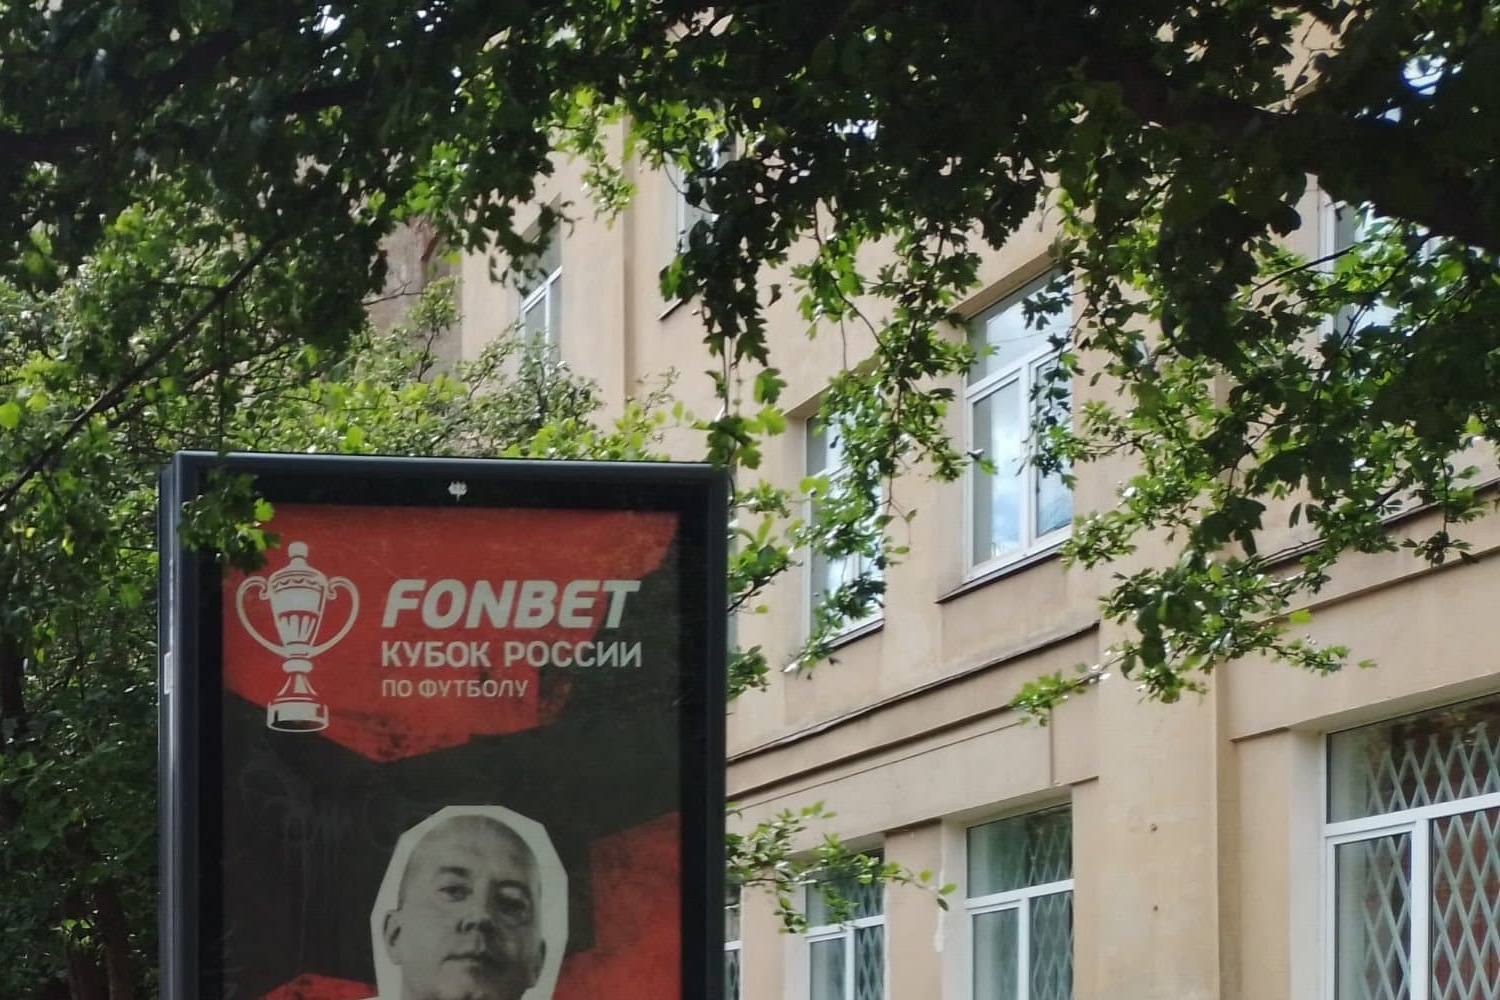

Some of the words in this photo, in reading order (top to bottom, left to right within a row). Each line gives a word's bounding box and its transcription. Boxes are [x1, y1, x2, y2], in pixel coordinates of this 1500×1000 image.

[382, 579, 641, 628] FONBET
[381, 641, 492, 667] КУБОК
[503, 641, 642, 667] РОССИИ
[382, 679, 413, 697] ПО
[418, 679, 528, 698] ФУТБОЛУ
